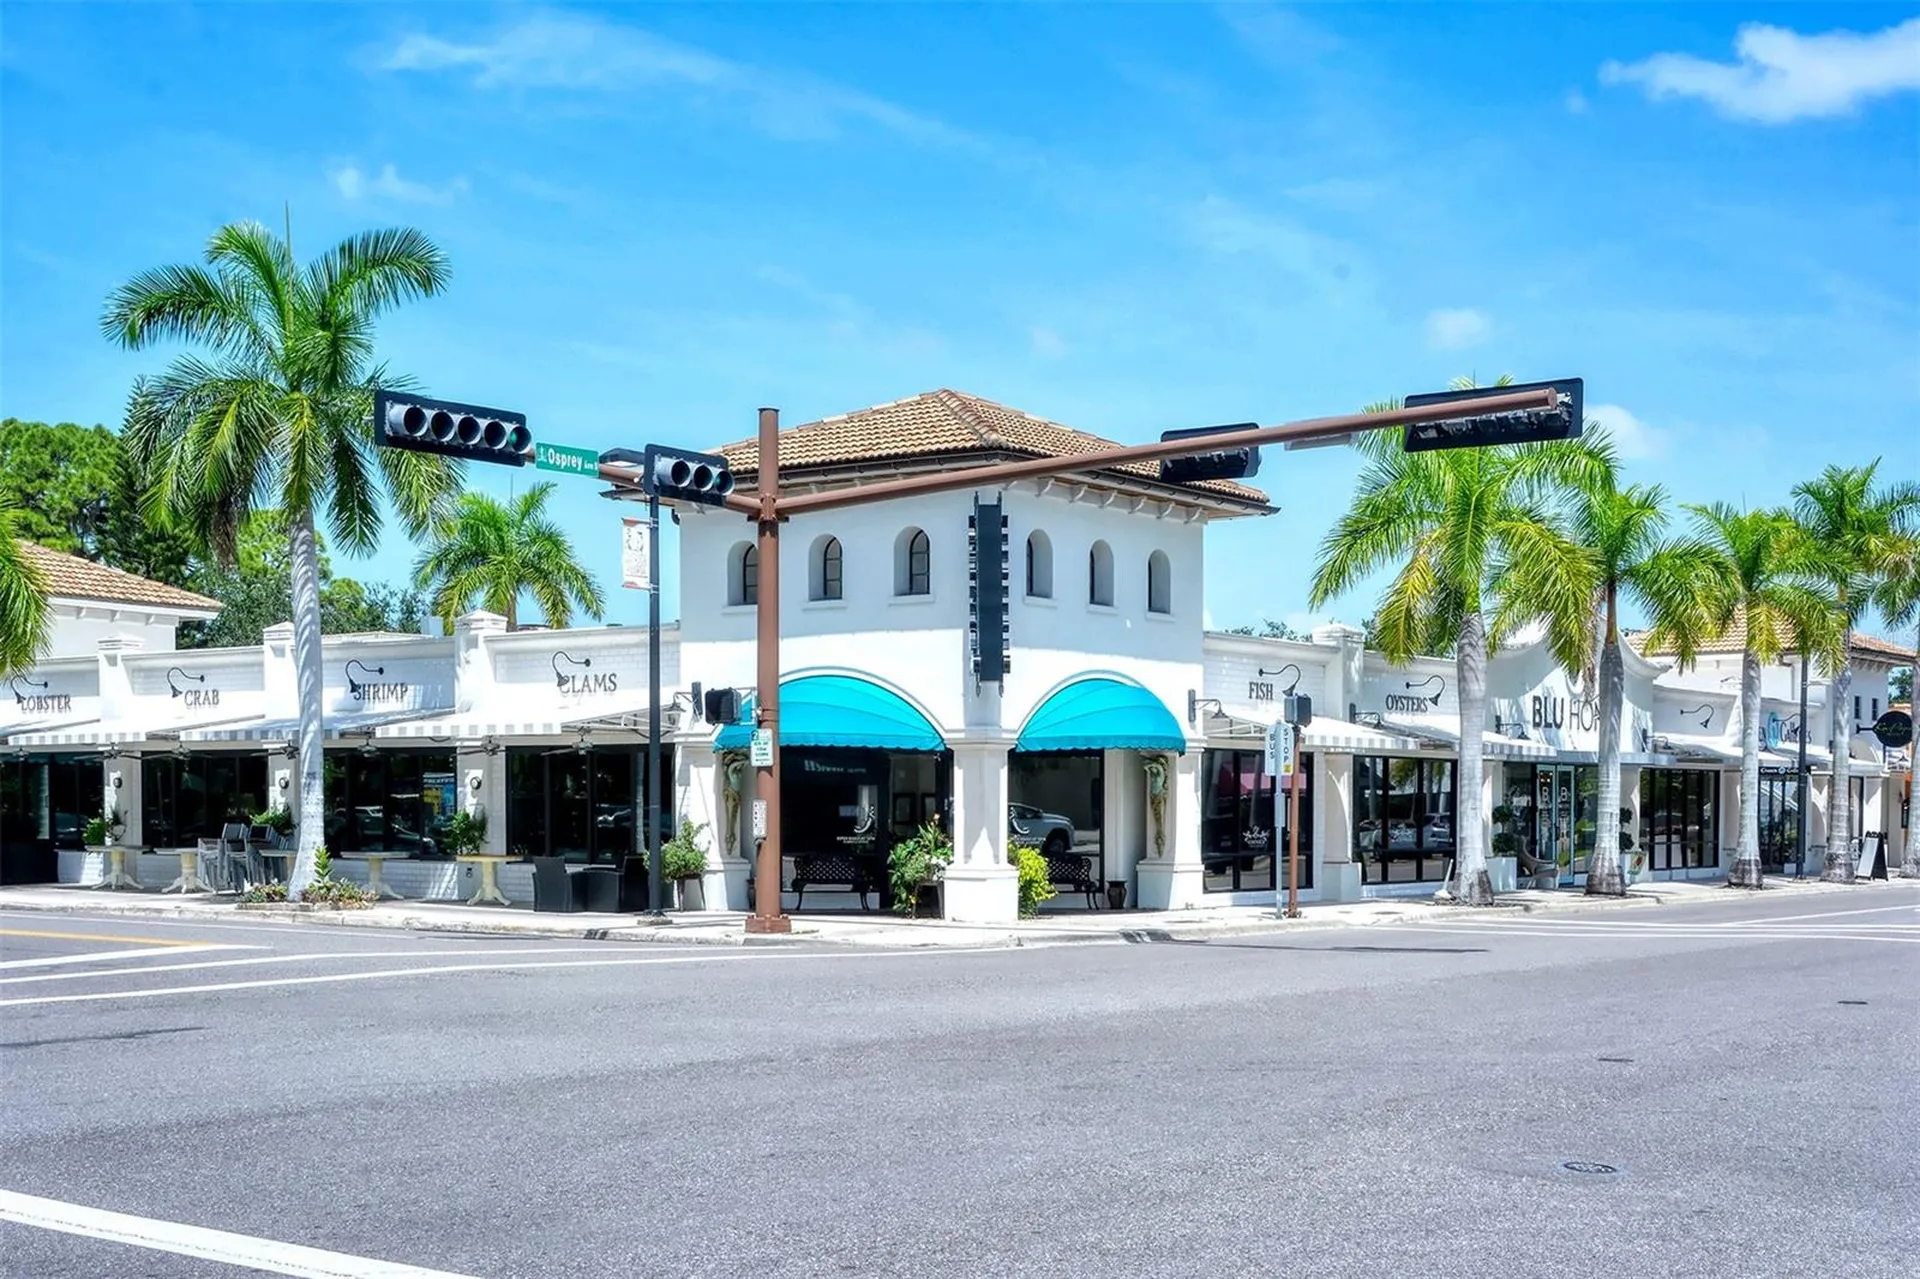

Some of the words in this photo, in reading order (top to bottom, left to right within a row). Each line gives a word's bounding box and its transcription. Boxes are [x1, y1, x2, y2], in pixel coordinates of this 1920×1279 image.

[548, 448, 582, 471] Osprey
[353, 683, 408, 701] SHRIMP
[560, 673, 617, 693] CLAMS
[1248, 681, 1273, 701] FISH
[21, 694, 71, 711] LOBSTER
[184, 689, 220, 706] CRAB
[1385, 694, 1428, 713] OYSTERS
[1532, 695, 1564, 729] BLU
[1569, 698, 1601, 732] HO
